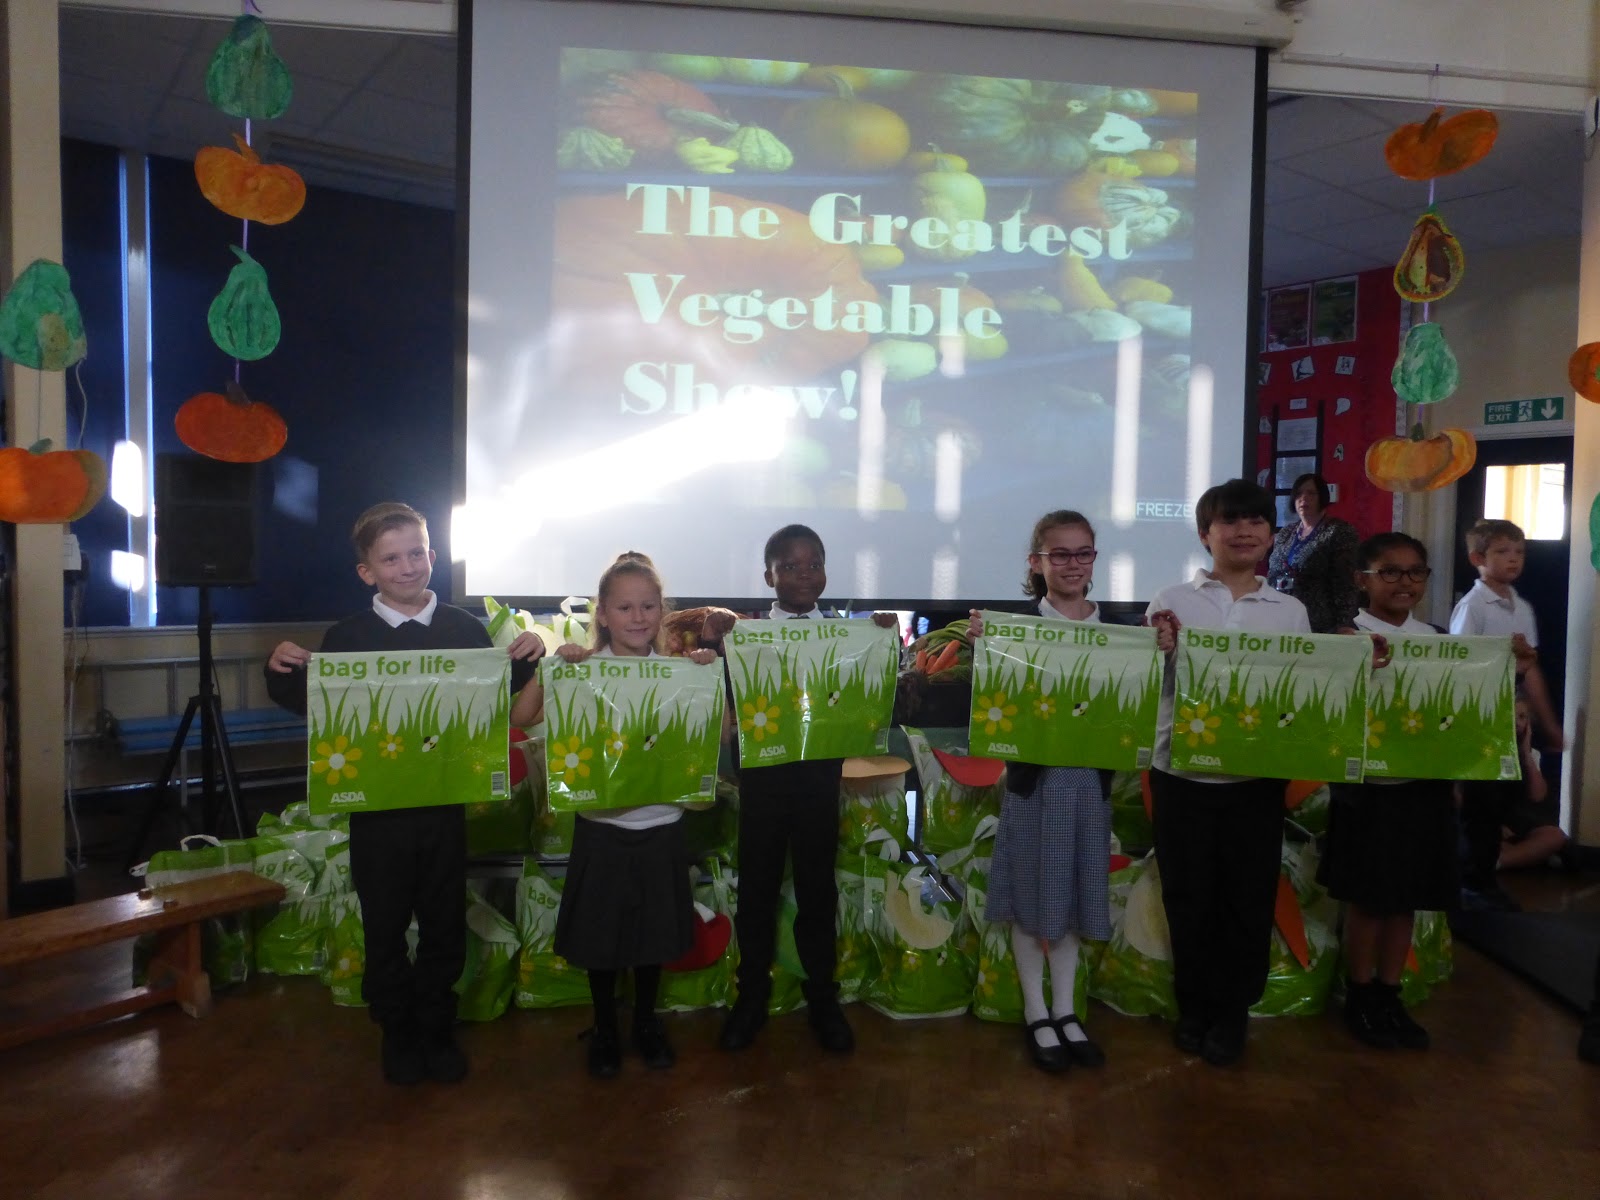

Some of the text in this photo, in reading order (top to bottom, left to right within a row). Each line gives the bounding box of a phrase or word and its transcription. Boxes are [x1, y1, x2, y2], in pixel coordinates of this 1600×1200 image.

[626, 183, 1133, 261] The Greatest
[624, 272, 1002, 344] Vegetable
[1488, 404, 1513, 413] FIRE
[1488, 413, 1512, 422] EXIT
[1136, 502, 1193, 518] FREEZE
[733, 624, 849, 646] bag for life
[984, 621, 1109, 647] bag for life
[1186, 630, 1316, 655] bag for life
[1402, 640, 1433, 658] for
[1438, 642, 1469, 659] life
[319, 655, 457, 680] bag for life
[600, 662, 631, 678] for
[639, 662, 673, 679] life
[759, 745, 786, 757] ASDA
[987, 742, 1019, 755] ASDA
[1189, 754, 1222, 766] ASDA
[330, 791, 366, 803] ASDA
[569, 789, 597, 801] ASDA
